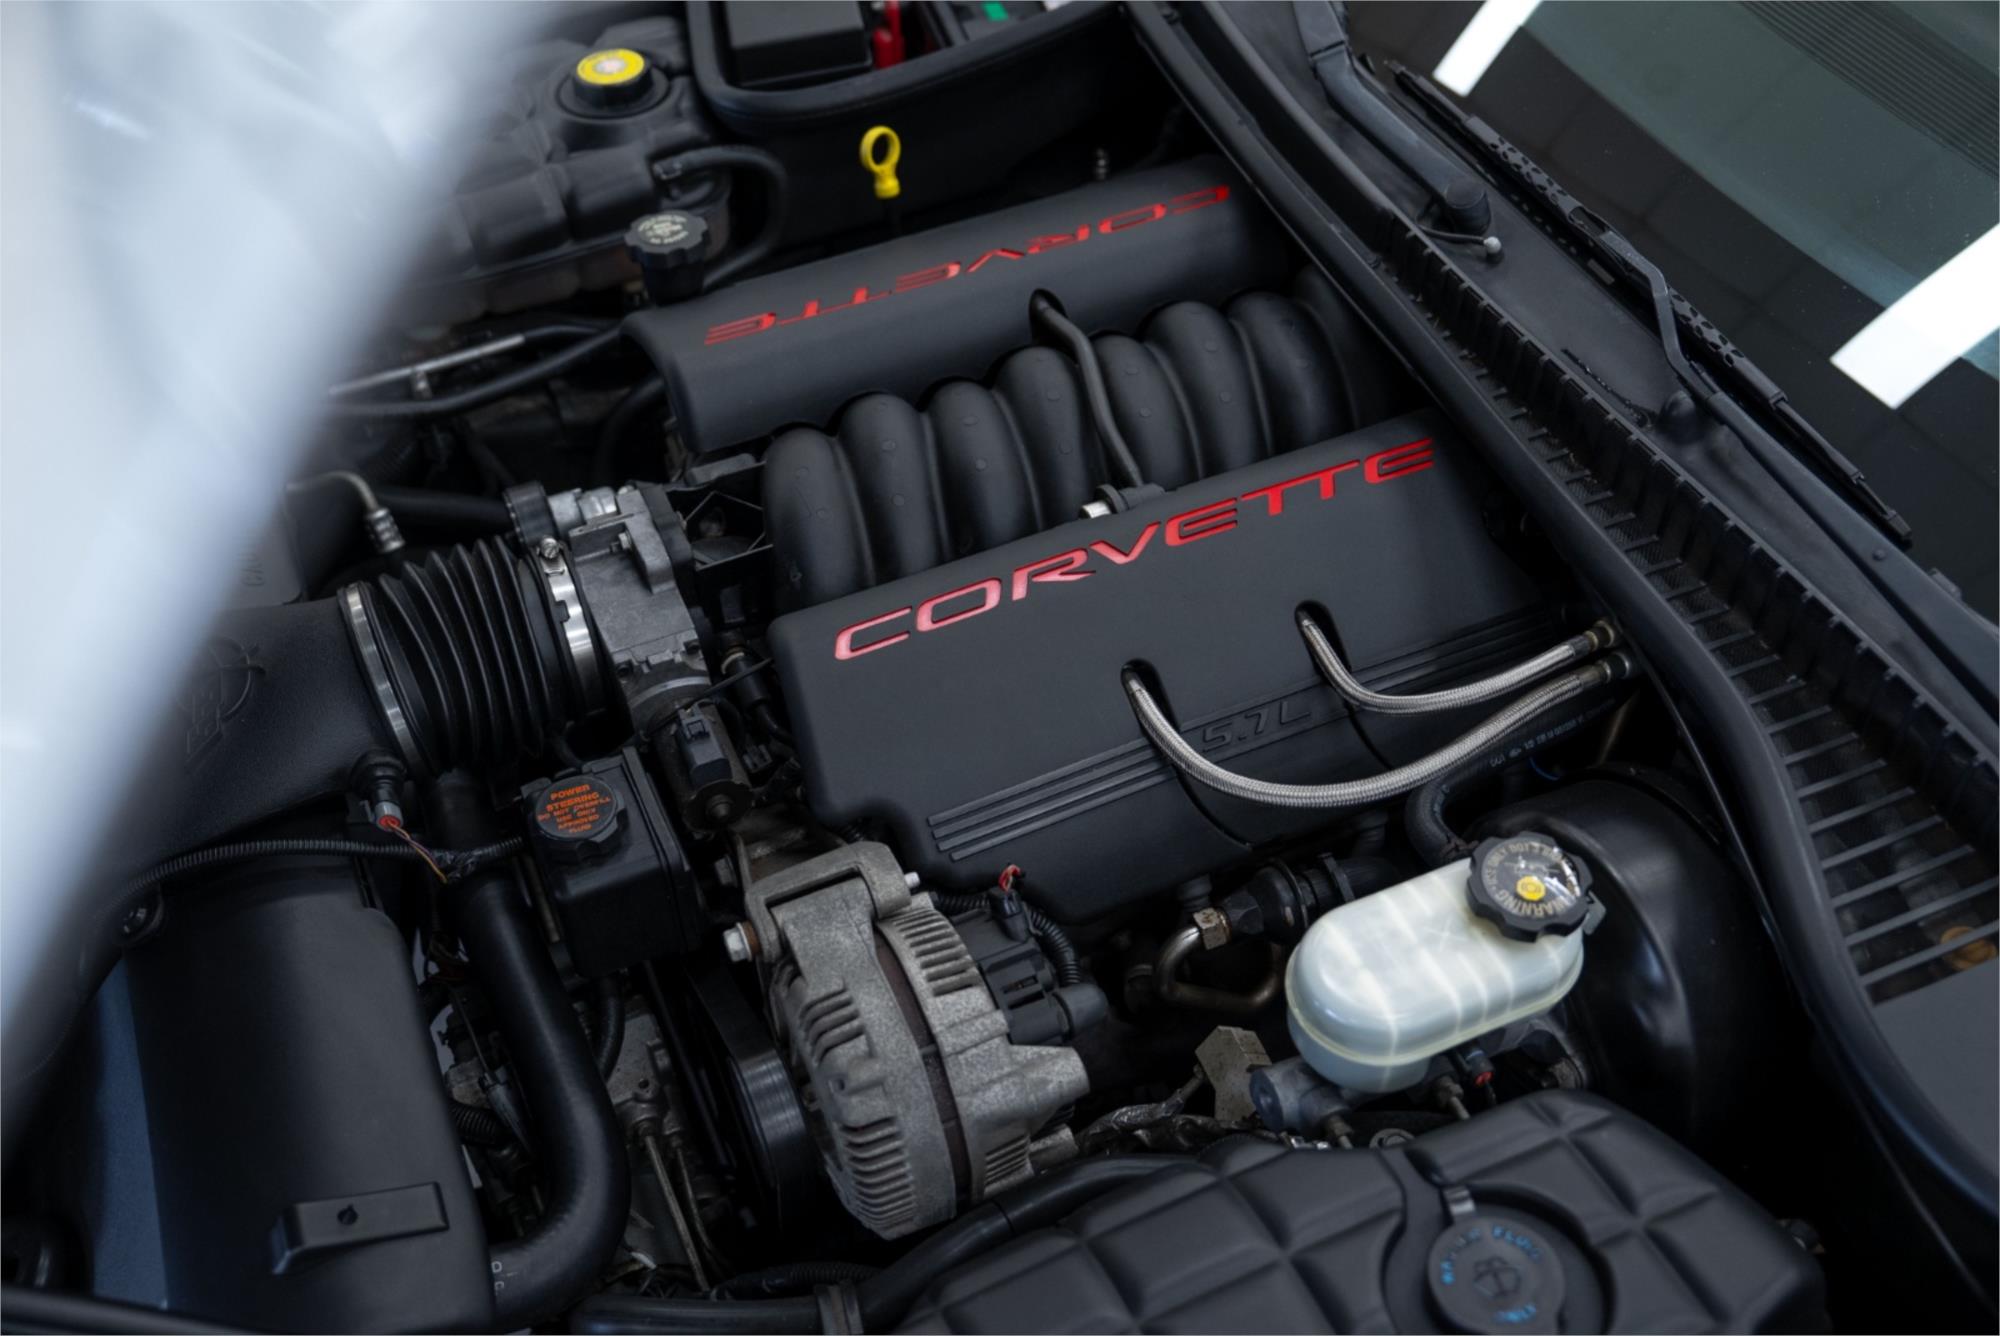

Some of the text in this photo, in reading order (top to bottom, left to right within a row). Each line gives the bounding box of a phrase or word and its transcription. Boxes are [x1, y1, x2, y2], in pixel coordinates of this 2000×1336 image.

[704, 185, 1230, 345] CORVETTE
[834, 437, 1435, 661] CORVETTE
[1201, 700, 1312, 753] 5.7L
[546, 791, 599, 812] STEERING
[551, 784, 590, 801] POWER
[1494, 889, 1571, 918] WARNING
